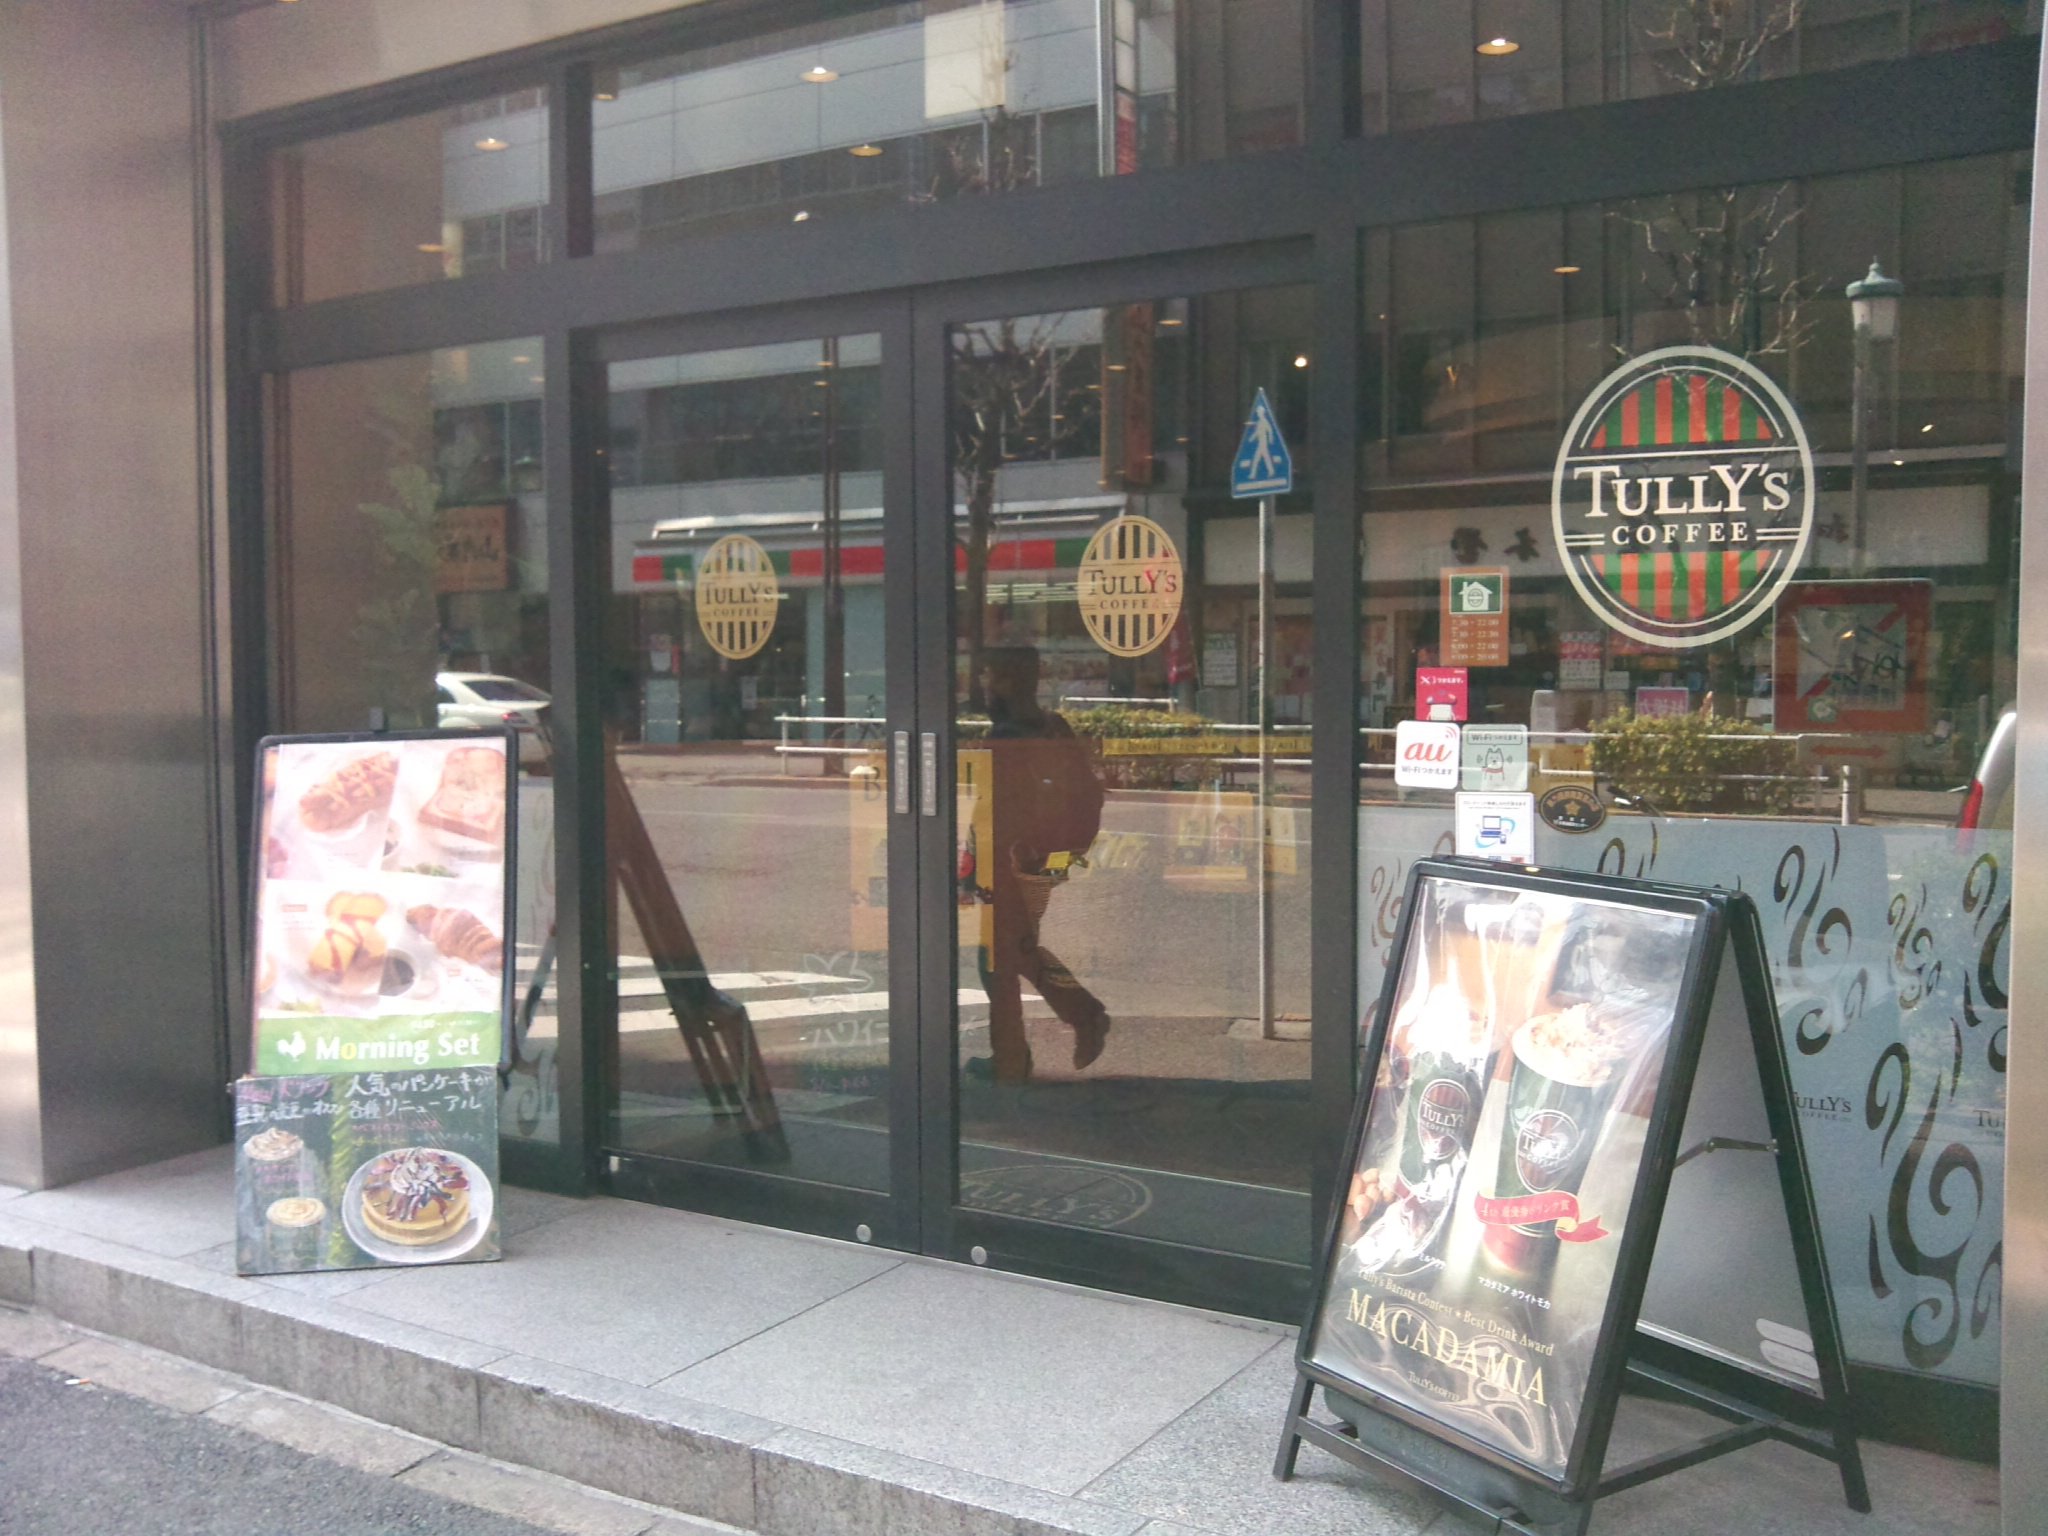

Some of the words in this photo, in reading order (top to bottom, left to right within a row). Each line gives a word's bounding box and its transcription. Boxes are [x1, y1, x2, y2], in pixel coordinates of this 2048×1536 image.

[1574, 462, 1791, 517] TULLY'S
[1612, 521, 1748, 545] COFFEE
[1084, 569, 1177, 596] TULLY'S
[714, 608, 759, 617] COFFEE
[1100, 599, 1161, 610] COFFEE
[1403, 742, 1452, 762] au
[315, 1033, 430, 1065] Morning
[438, 1032, 480, 1056] Set
[1346, 1287, 1548, 1406] MACADAMIA
[1463, 1310, 1486, 1330] Best
[1487, 1319, 1518, 1342] Drink
[1519, 1333, 1555, 1357] Award
